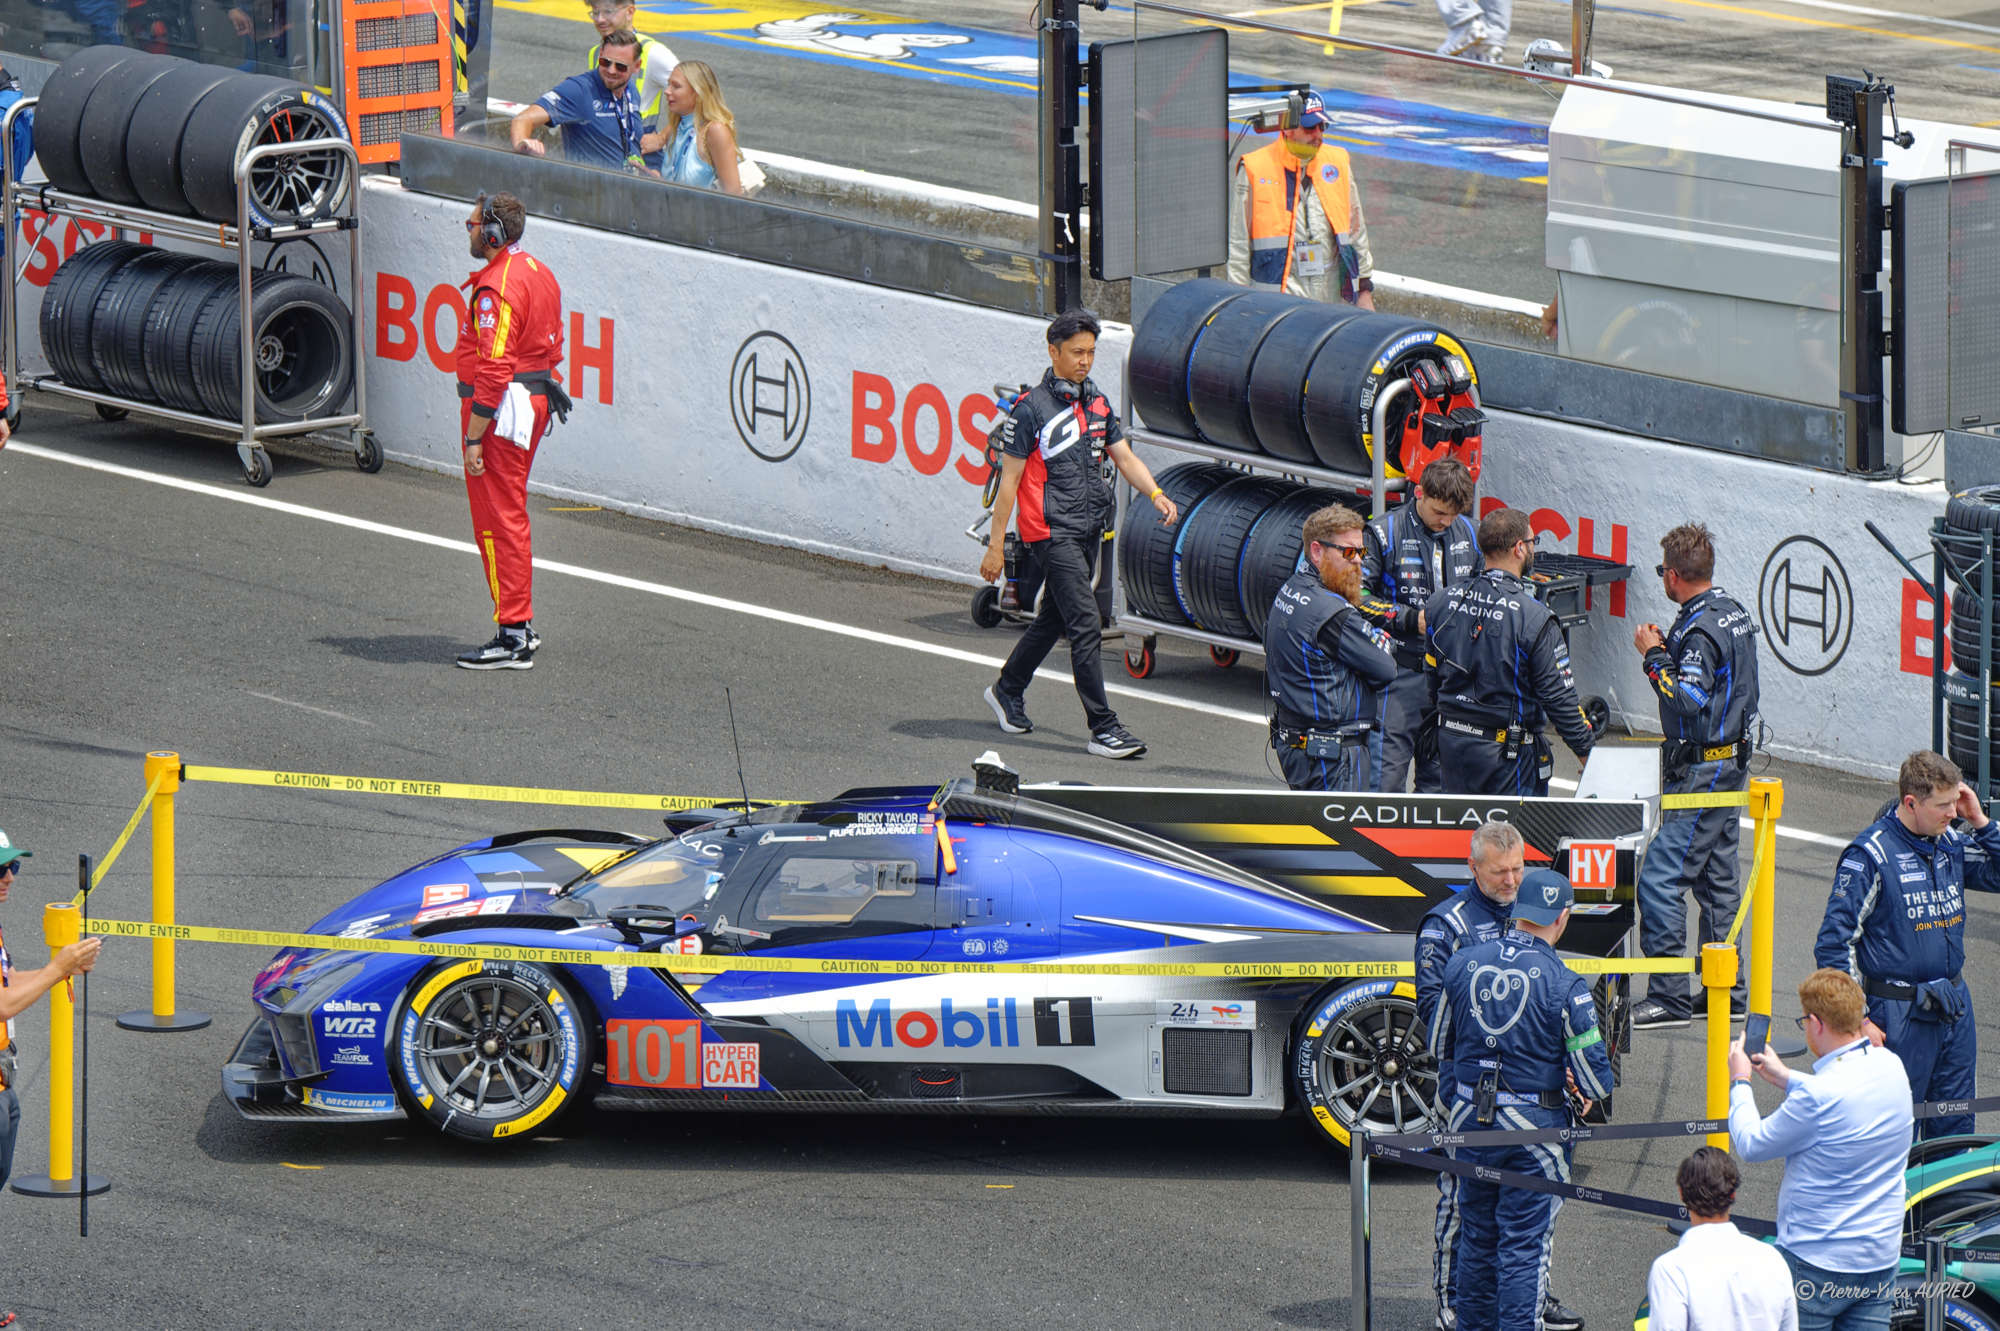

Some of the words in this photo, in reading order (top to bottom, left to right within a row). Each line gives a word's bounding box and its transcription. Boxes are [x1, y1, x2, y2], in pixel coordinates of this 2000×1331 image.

[376, 272, 614, 405] BOH
[1387, 333, 1433, 358] MICHELIN
[851, 370, 999, 486] BOS
[1448, 588, 1521, 611] CADILLAC
[1448, 601, 1504, 620] RACING
[274, 773, 330, 788] CAUTION
[346, 778, 364, 790] DO
[369, 780, 396, 793] NOT
[401, 782, 441, 795] ENTER
[661, 797, 716, 810] CAUTION
[858, 812, 883, 823] RICKY
[885, 812, 918, 823] TAYLOR
[1323, 804, 1509, 825] CADILLAC
[1571, 849, 1613, 883] HY
[1903, 891, 1929, 906] THE
[1907, 906, 1925, 919] OF
[91, 921, 109, 933] DO
[116, 922, 143, 935] NOT
[149, 924, 190, 938] ENTER
[1915, 921, 1932, 932] JOIN
[418, 943, 477, 957] CAUTION
[493, 948, 512, 960] DO
[518, 949, 545, 962] NOT
[552, 951, 592, 963] ENTER
[681, 935, 696, 954] E
[965, 942, 984, 953] FIA
[467, 961, 478, 973] M
[821, 961, 879, 974] CAUTION
[896, 962, 914, 973] DO
[920, 962, 947, 973] NOT
[953, 962, 995, 974] ENTER
[1224, 965, 1282, 976] CAUTION
[1299, 964, 1317, 976] DO
[1323, 964, 1350, 976] NOT
[1357, 964, 1398, 975] ENTER
[323, 1000, 382, 1012] dallara
[1171, 1003, 1199, 1017] 24h
[1325, 983, 1387, 1018] MICHELIN
[324, 1017, 377, 1033] WTR
[835, 998, 1019, 1048] Mobil
[402, 1017, 417, 1085] MICHELIN
[561, 1014, 577, 1084] MICHELIN
[607, 1025, 698, 1084] 101
[706, 1045, 756, 1059] HYPER
[706, 1060, 756, 1083] CAR
[325, 1097, 386, 1108] MICHELIN
